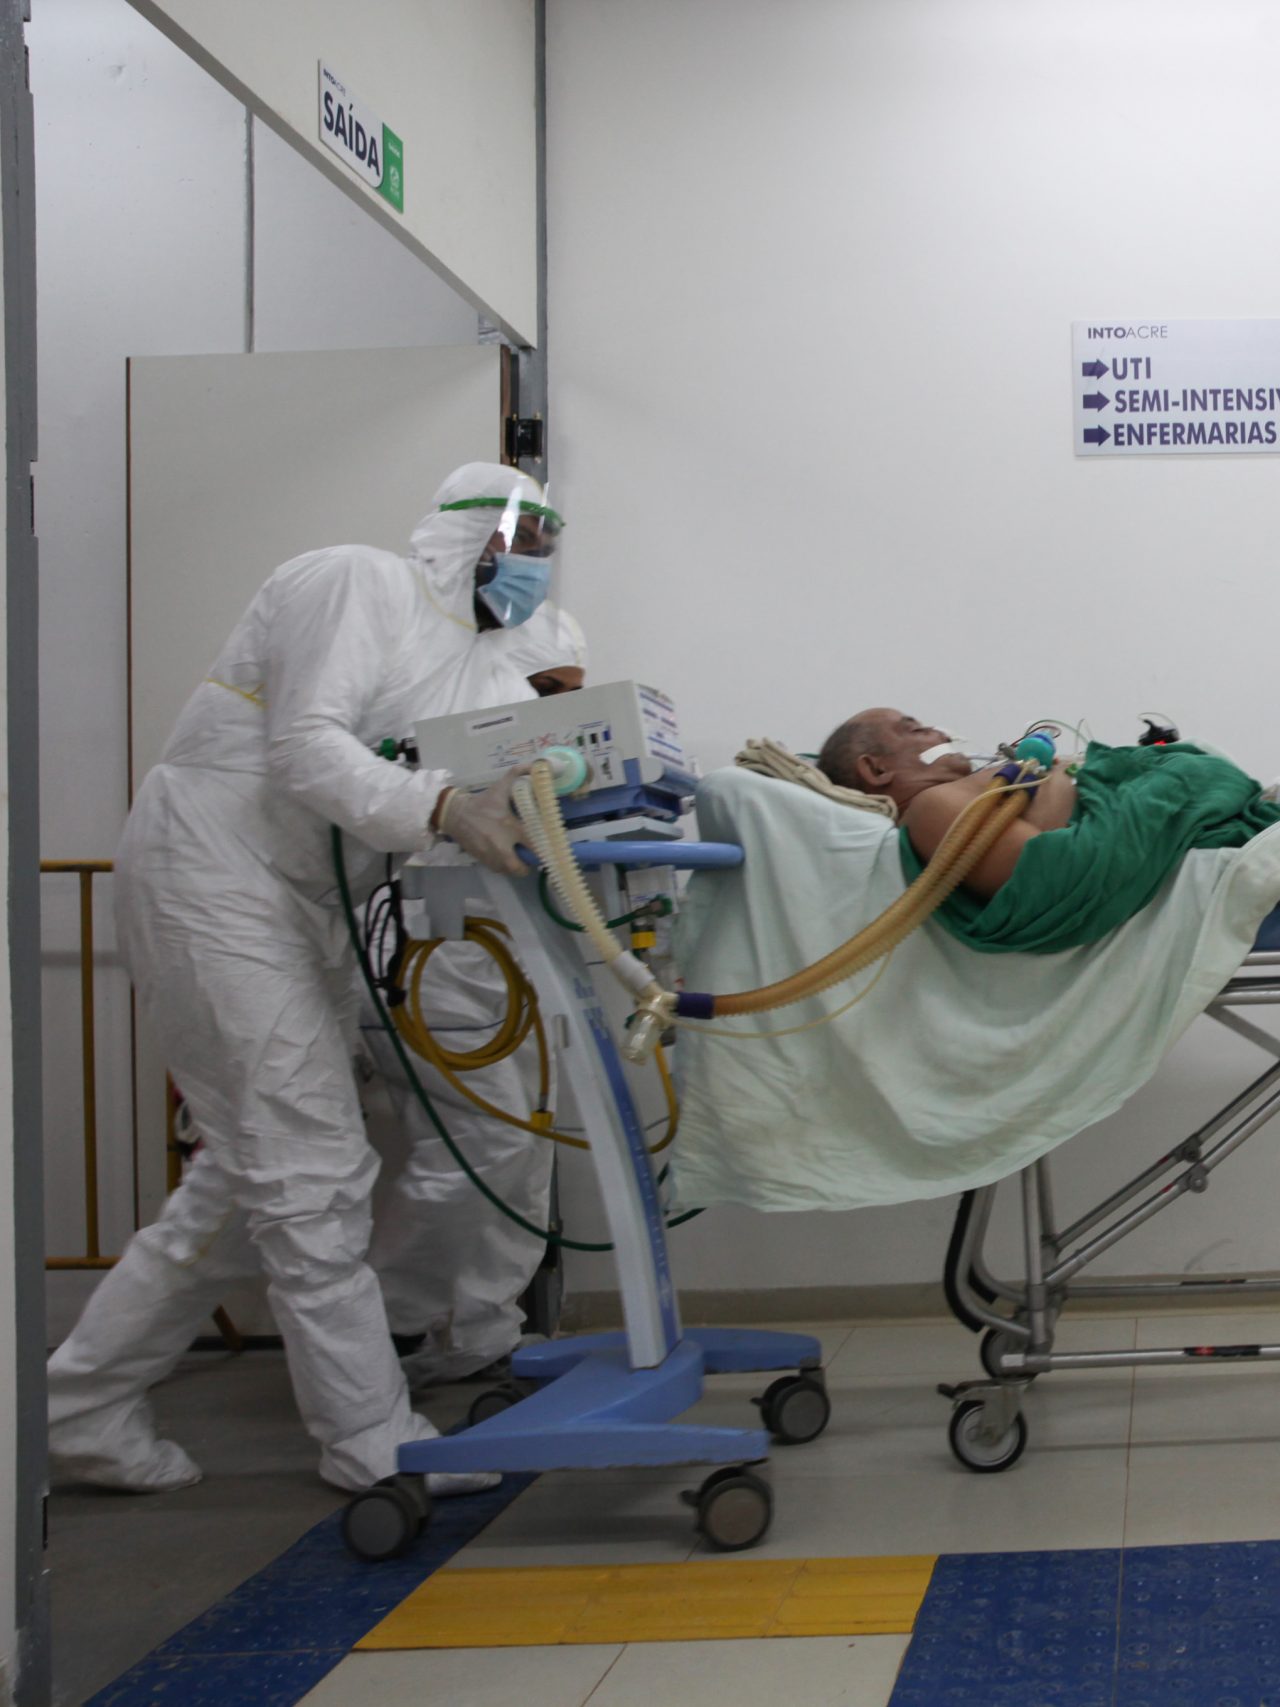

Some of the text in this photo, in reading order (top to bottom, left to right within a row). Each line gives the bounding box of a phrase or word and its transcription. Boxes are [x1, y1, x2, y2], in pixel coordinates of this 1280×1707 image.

[323, 91, 380, 176] SAÍDA
[1087, 325, 1168, 339] INTOACRE
[1111, 357, 1151, 380] UTI
[1114, 421, 1277, 445] ENFERMARIAS
